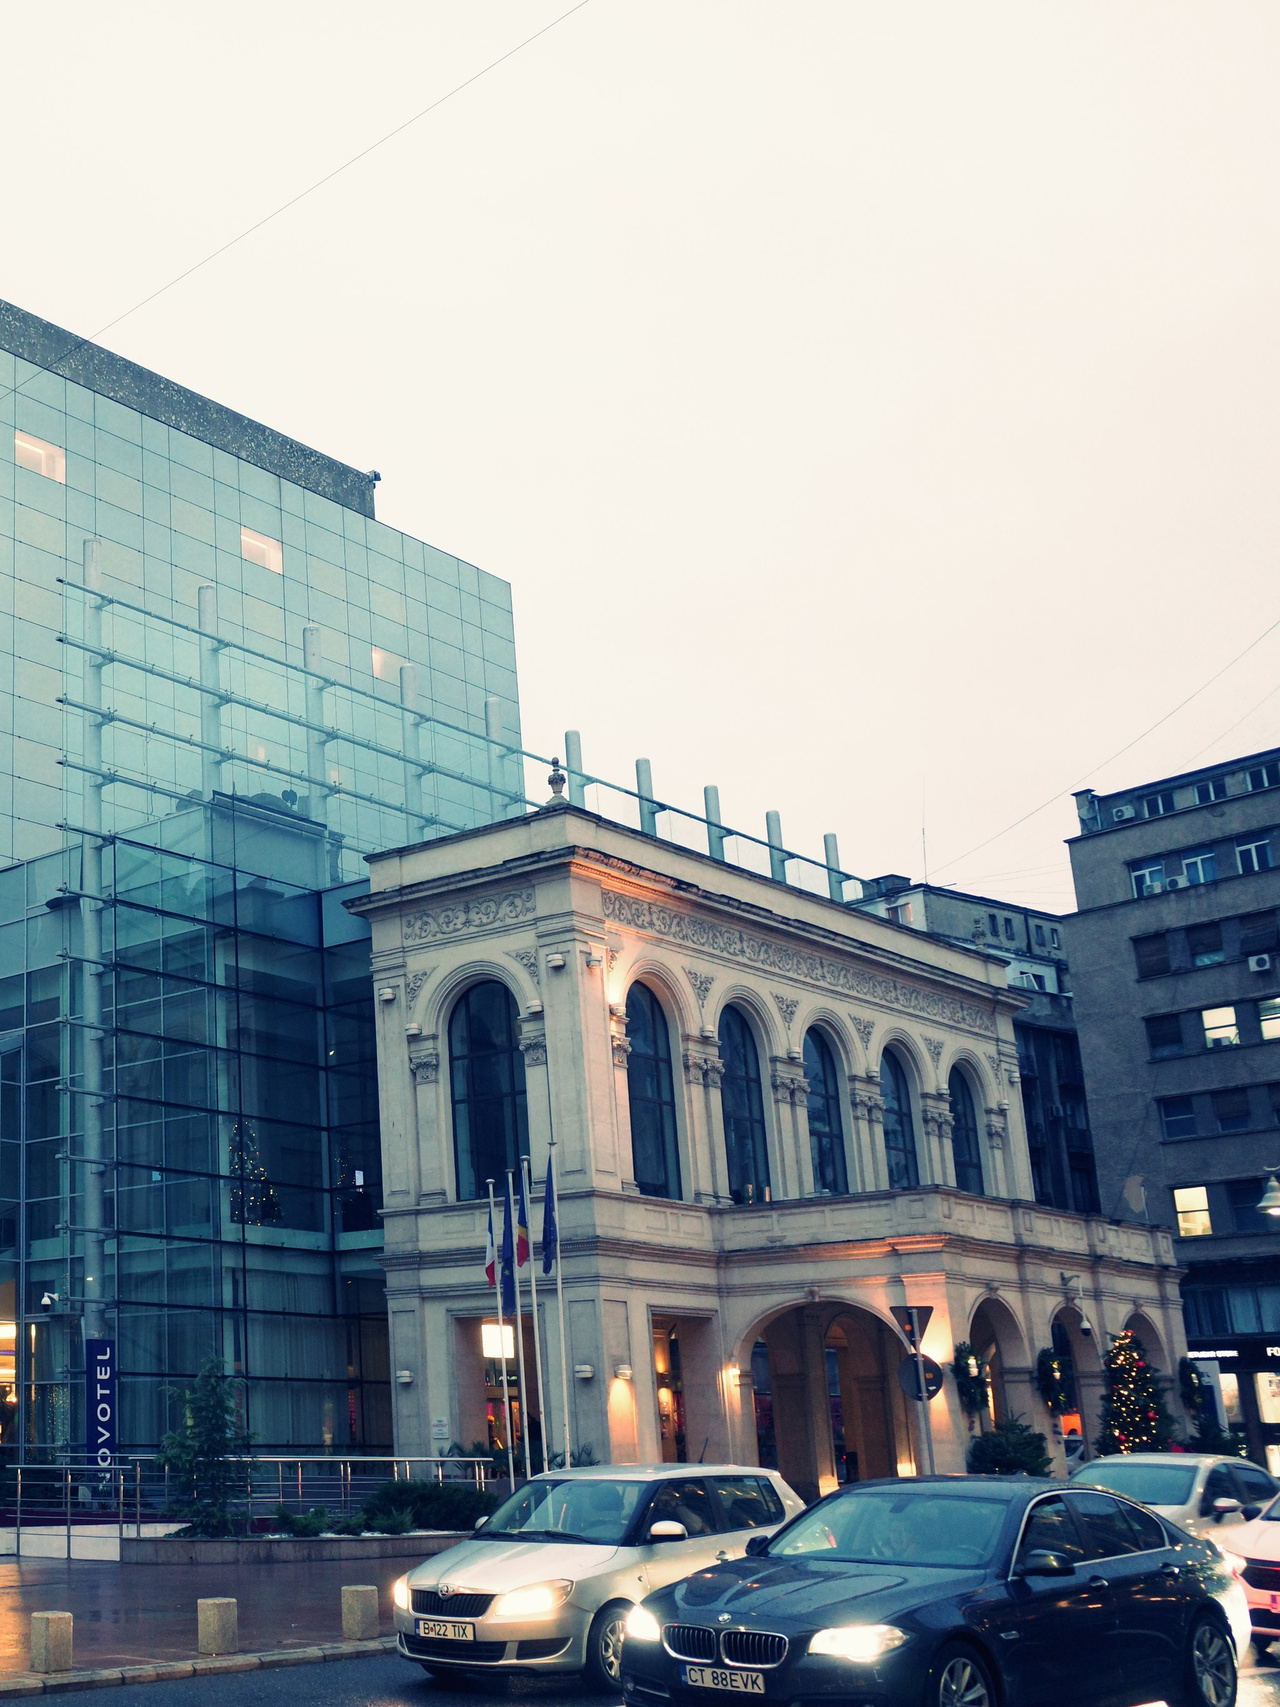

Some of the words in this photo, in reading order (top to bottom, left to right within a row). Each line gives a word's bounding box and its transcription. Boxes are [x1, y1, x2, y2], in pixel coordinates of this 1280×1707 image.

[423, 1622, 430, 1635] B
[433, 1623, 448, 1637] 122
[451, 1624, 468, 1638] TIX
[688, 1668, 705, 1684] CT
